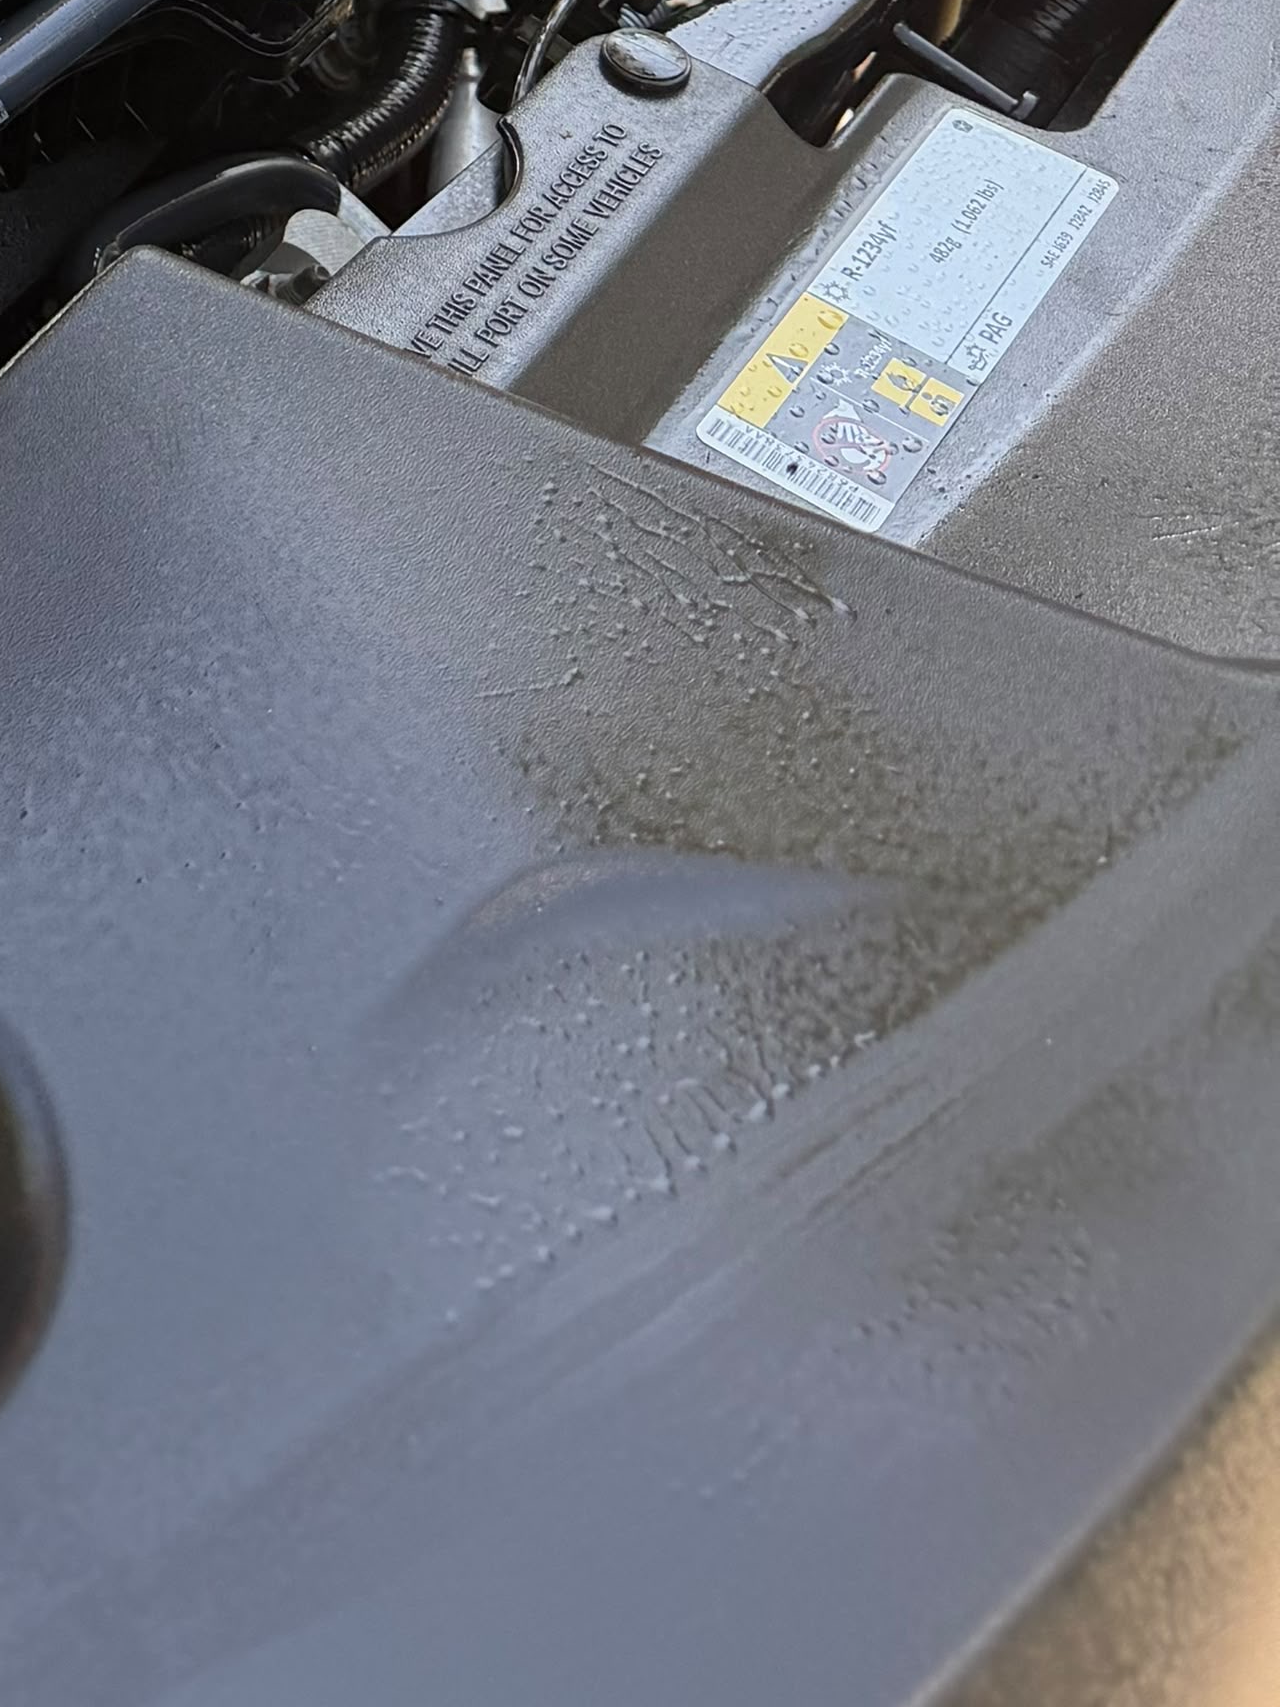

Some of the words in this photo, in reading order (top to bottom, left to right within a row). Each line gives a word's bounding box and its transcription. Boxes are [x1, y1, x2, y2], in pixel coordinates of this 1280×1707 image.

[426, 291, 478, 335] THIS
[463, 242, 527, 297] PANEL
[510, 206, 557, 244] FOR
[542, 145, 609, 212] ACCESS
[593, 122, 628, 148] TO
[474, 295, 529, 349] PORT
[518, 266, 556, 300] ON
[542, 217, 599, 272] SOME
[582, 141, 664, 220] VEHICLES
[840, 220, 897, 282] R-1234yf
[929, 236, 963, 265] 482g
[951, 198, 985, 235] (1.062
[1040, 250, 1061, 269] SAE
[978, 311, 1014, 345] PAG
